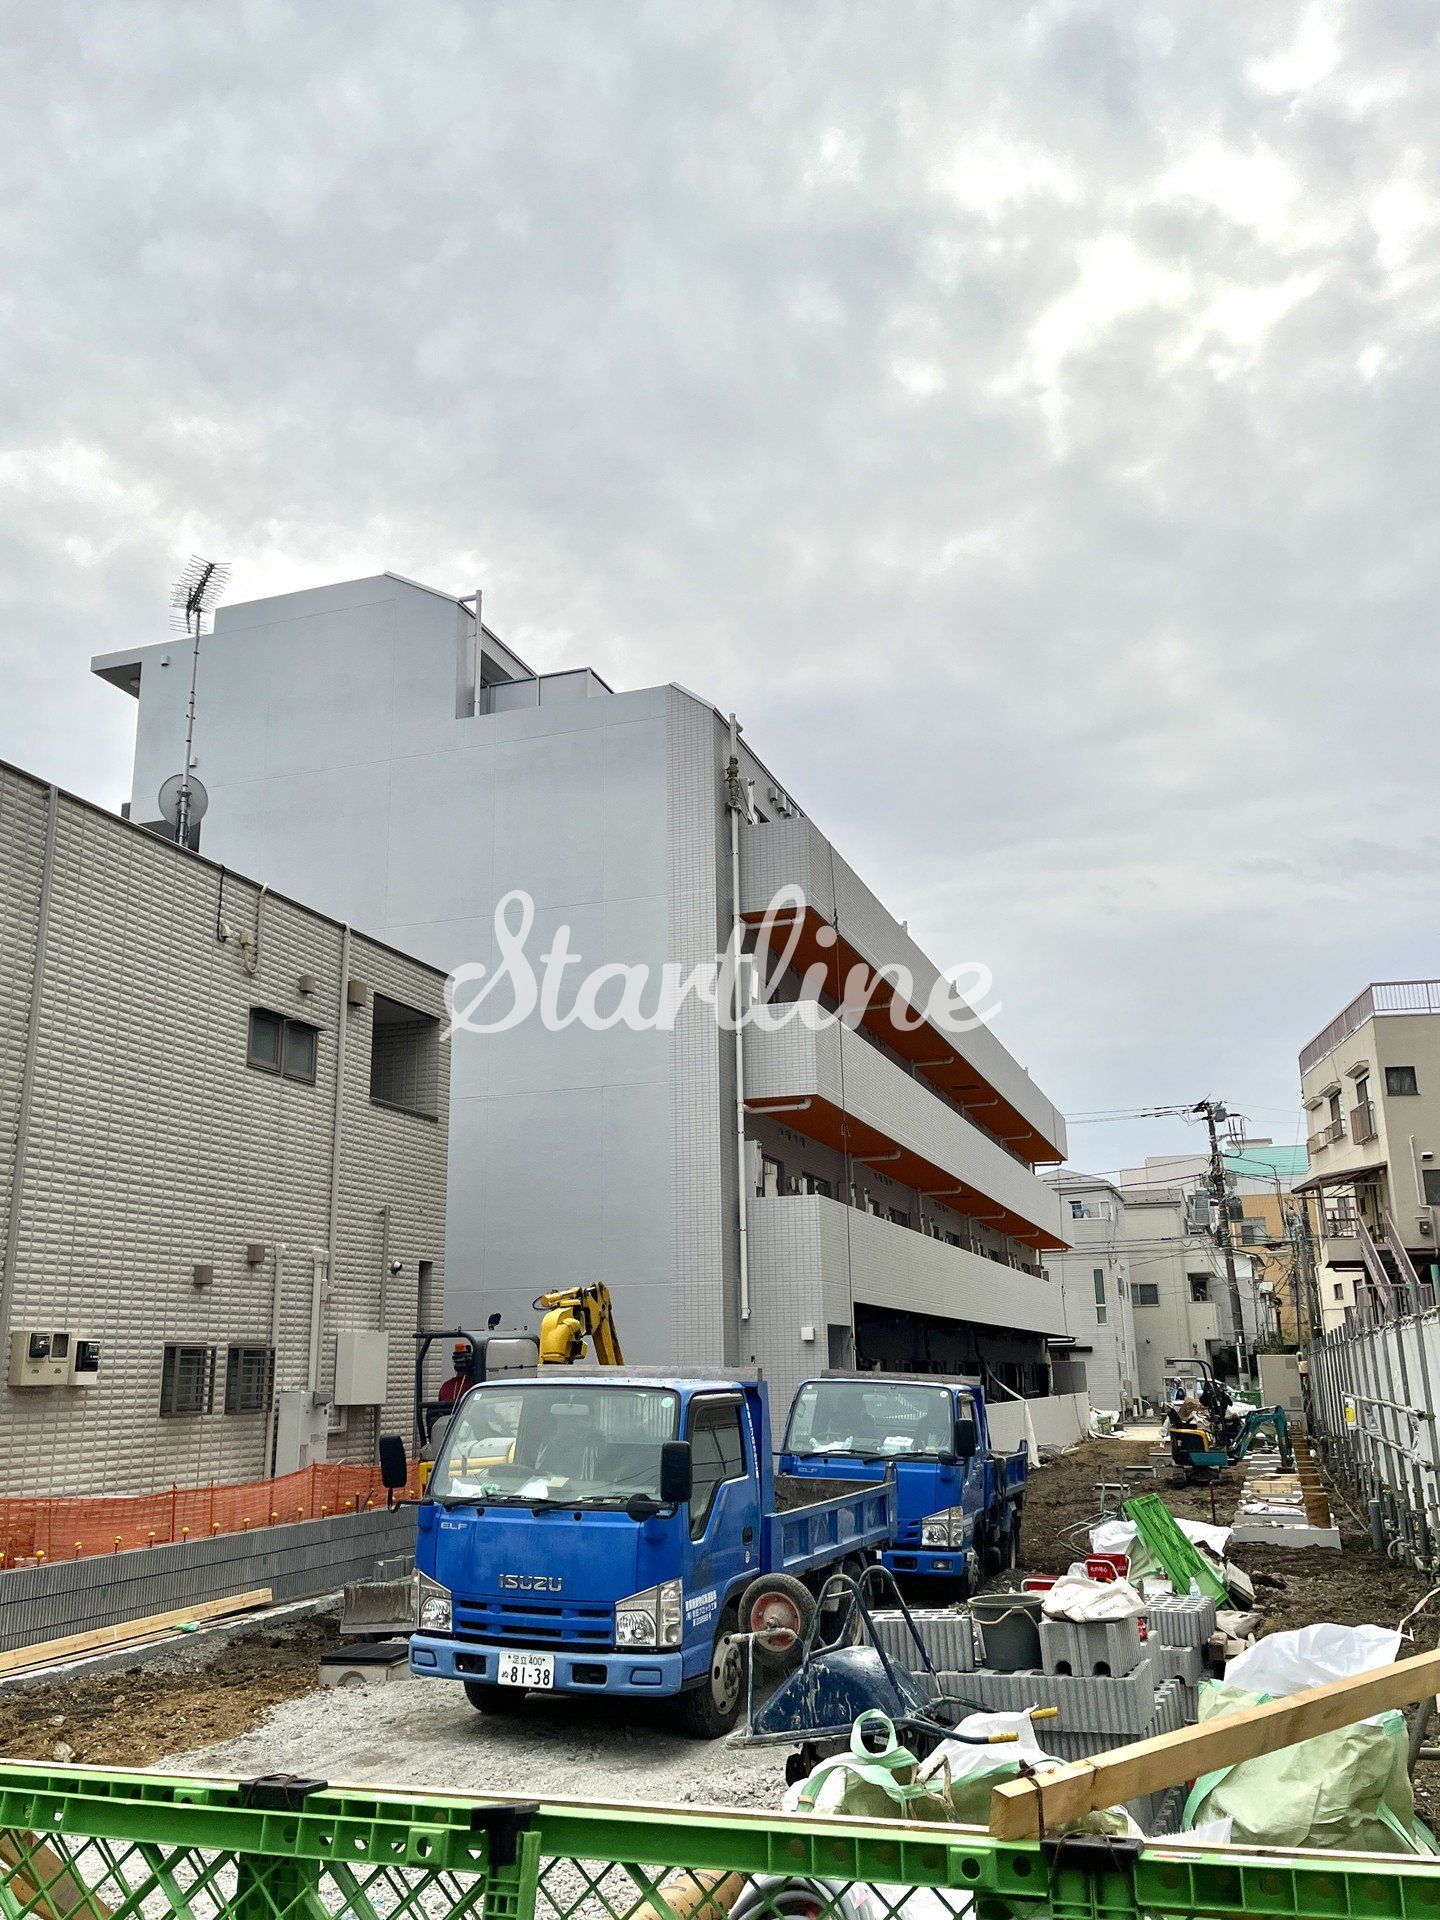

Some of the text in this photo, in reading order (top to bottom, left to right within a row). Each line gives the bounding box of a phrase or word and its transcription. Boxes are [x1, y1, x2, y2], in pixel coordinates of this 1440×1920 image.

[440, 1522, 468, 1530] ELF
[499, 1574, 562, 1592] ISUZU
[512, 1655, 543, 1666] 足立 400
[510, 1666, 551, 1686] 81-38
